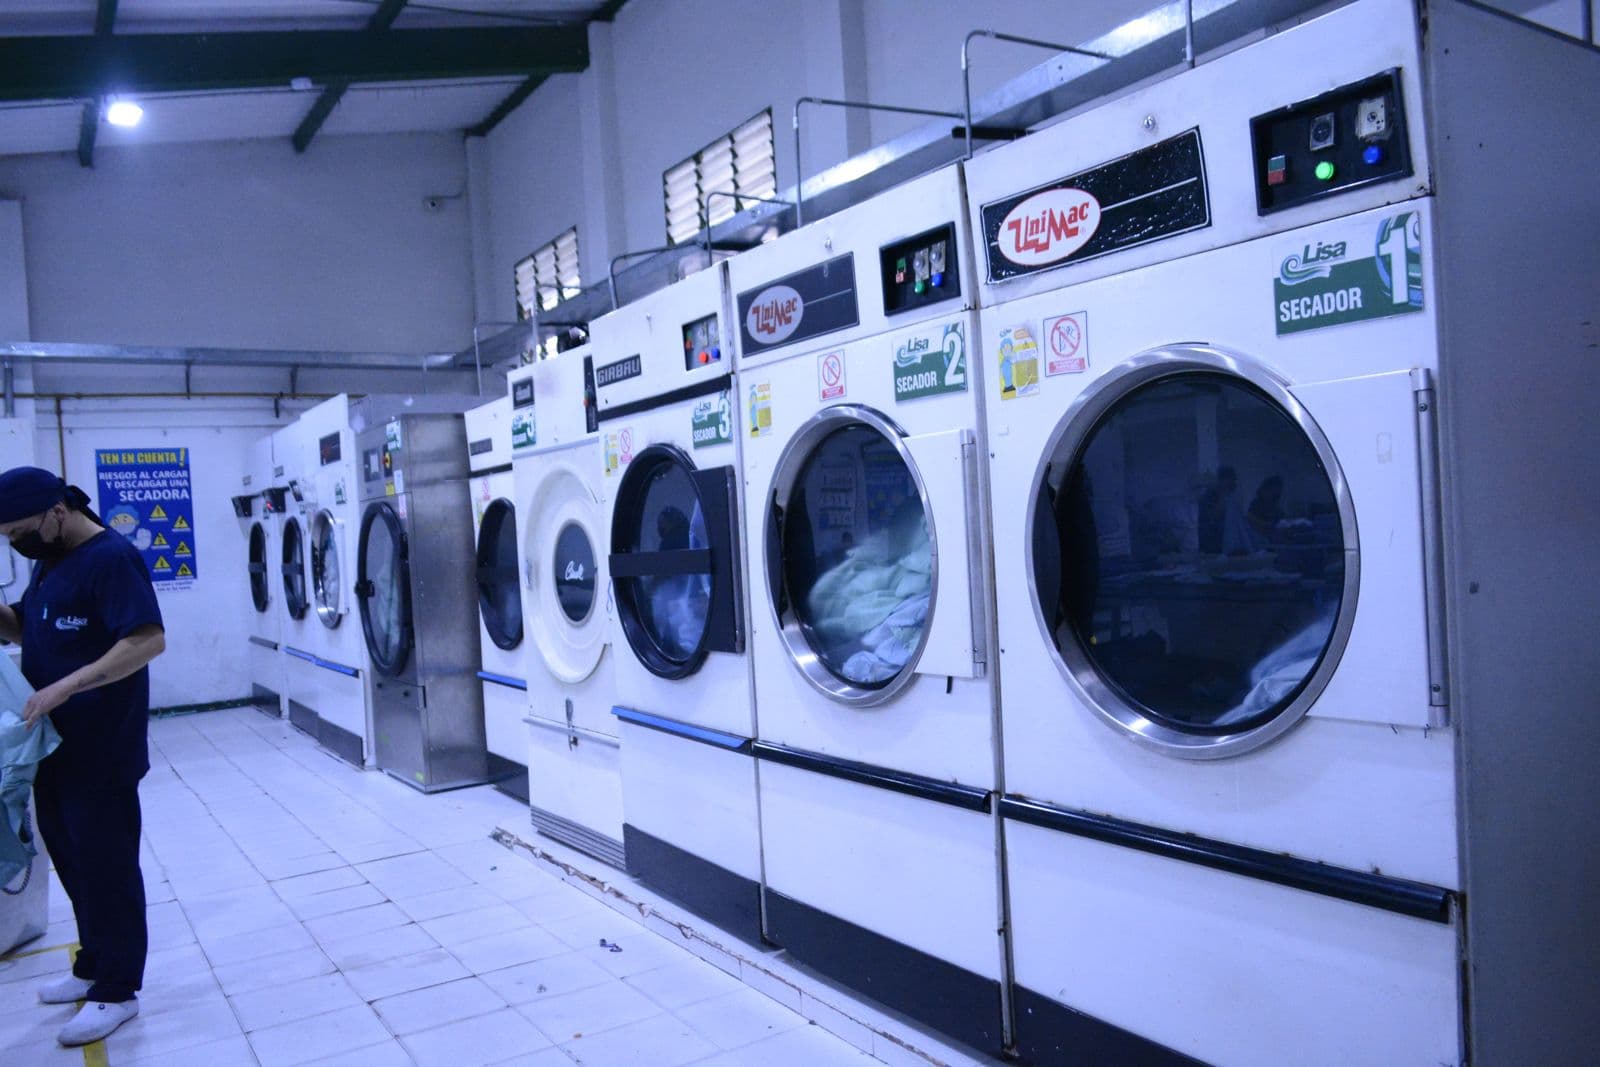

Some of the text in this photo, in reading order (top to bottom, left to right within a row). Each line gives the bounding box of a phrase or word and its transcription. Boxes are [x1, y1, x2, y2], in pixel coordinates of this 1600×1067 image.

[1007, 202, 1089, 253] UniMac
[1302, 241, 1347, 264] Lisa
[1379, 227, 1408, 304] 1
[752, 297, 798, 334] UniMac
[1280, 287, 1363, 322] SECADOR
[906, 337, 929, 352] Lisa
[597, 357, 640, 384] GIRBAU
[942, 332, 964, 386] 2
[896, 371, 938, 393] SECADOR
[718, 399, 730, 438] 3
[693, 427, 716, 440] SECADOR
[99, 453, 119, 464] TEN
[122, 452, 134, 464] EN
[137, 452, 177, 464] CUENTA
[99, 472, 137, 480] RIESGOS
[152, 470, 188, 478] CARGAR
[106, 481, 112, 489] Y
[114, 480, 167, 488] DESCARGAR
[120, 489, 190, 502] SECADORA
